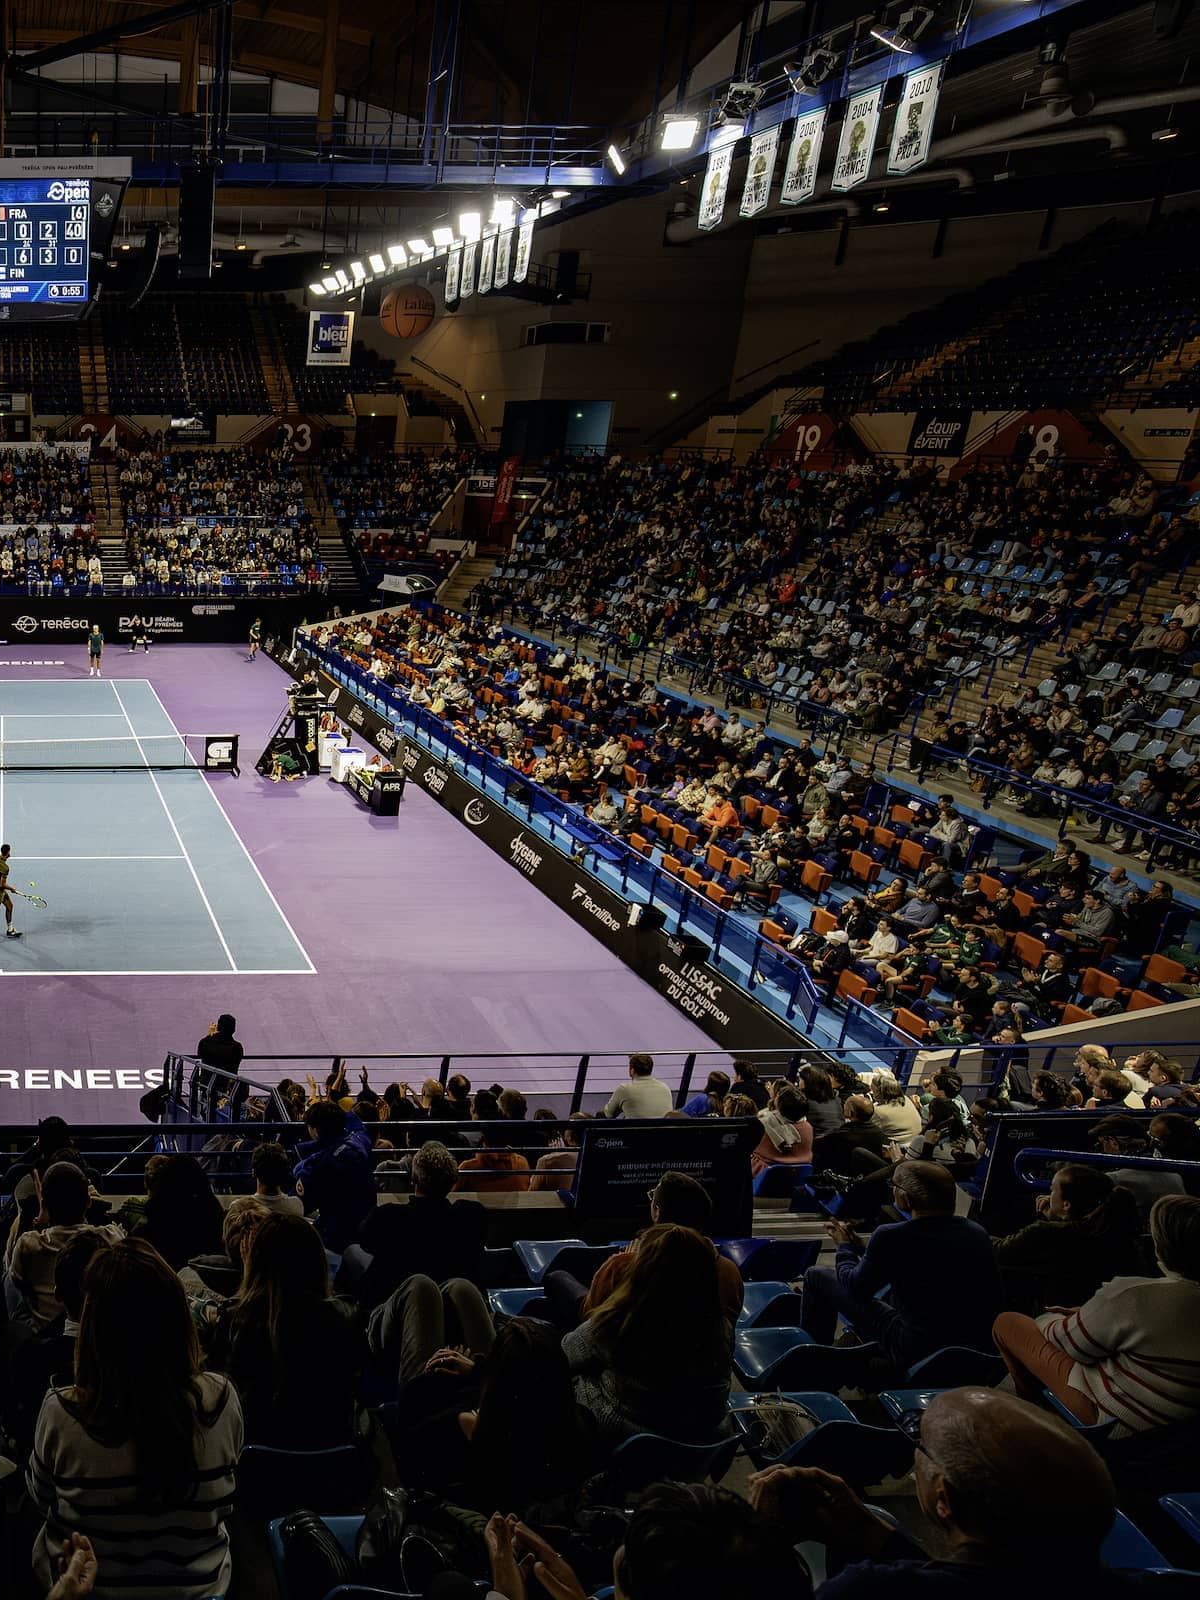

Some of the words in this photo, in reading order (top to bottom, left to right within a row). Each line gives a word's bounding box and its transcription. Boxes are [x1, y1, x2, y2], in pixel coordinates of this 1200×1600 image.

[910, 76, 933, 99] 2010
[852, 99, 874, 120] 2004
[836, 158, 866, 180] FRANCE
[9, 209, 28, 219] FRA
[20, 224, 27, 238] 0
[45, 224, 52, 237] 2
[66, 224, 81, 237] 40
[20, 250, 27, 263] 6
[45, 250, 52, 262] 3
[70, 250, 77, 262] 0
[10, 268, 24, 278] FIN
[62, 286, 80, 295] 0:55
[318, 327, 348, 342] bleu
[794, 424, 821, 462] 19
[383, 782, 400, 791] APR
[582, 894, 620, 931] Tecnifibre
[680, 962, 722, 1000] LISSAC
[658, 964, 688, 990] OPTIQUE
[686, 984, 697, 997] ET
[694, 992, 730, 1026] AUDITION
[667, 984, 682, 999] DU
[680, 996, 705, 1019] GOLF
